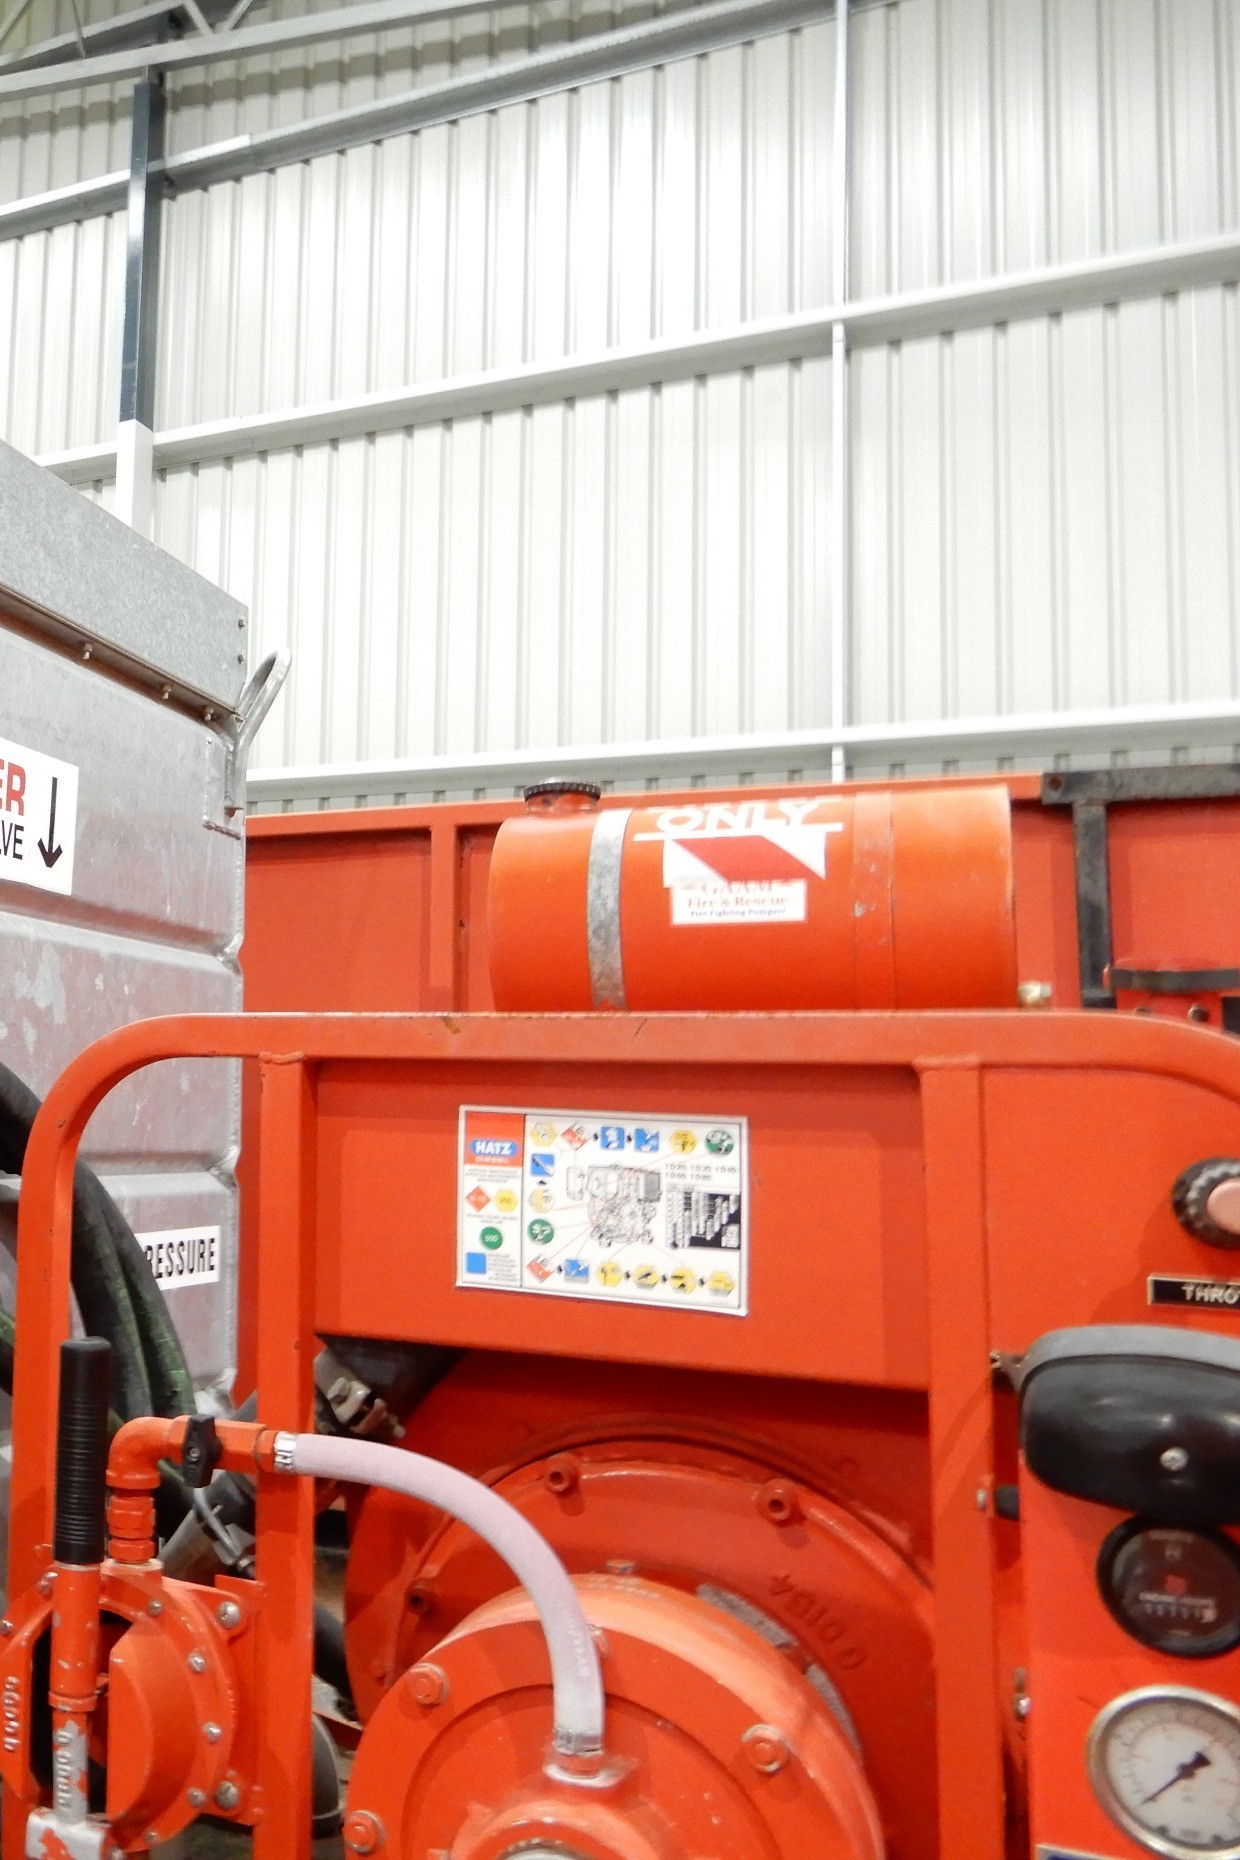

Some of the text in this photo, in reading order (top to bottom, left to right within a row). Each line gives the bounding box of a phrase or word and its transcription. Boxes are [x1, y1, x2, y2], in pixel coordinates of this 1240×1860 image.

[657, 801, 820, 832] ONLY
[687, 898, 717, 909] Fire
[734, 896, 788, 907] Rescue
[475, 1139, 513, 1155] HATZ
[1181, 1284, 1240, 1305] THRO
